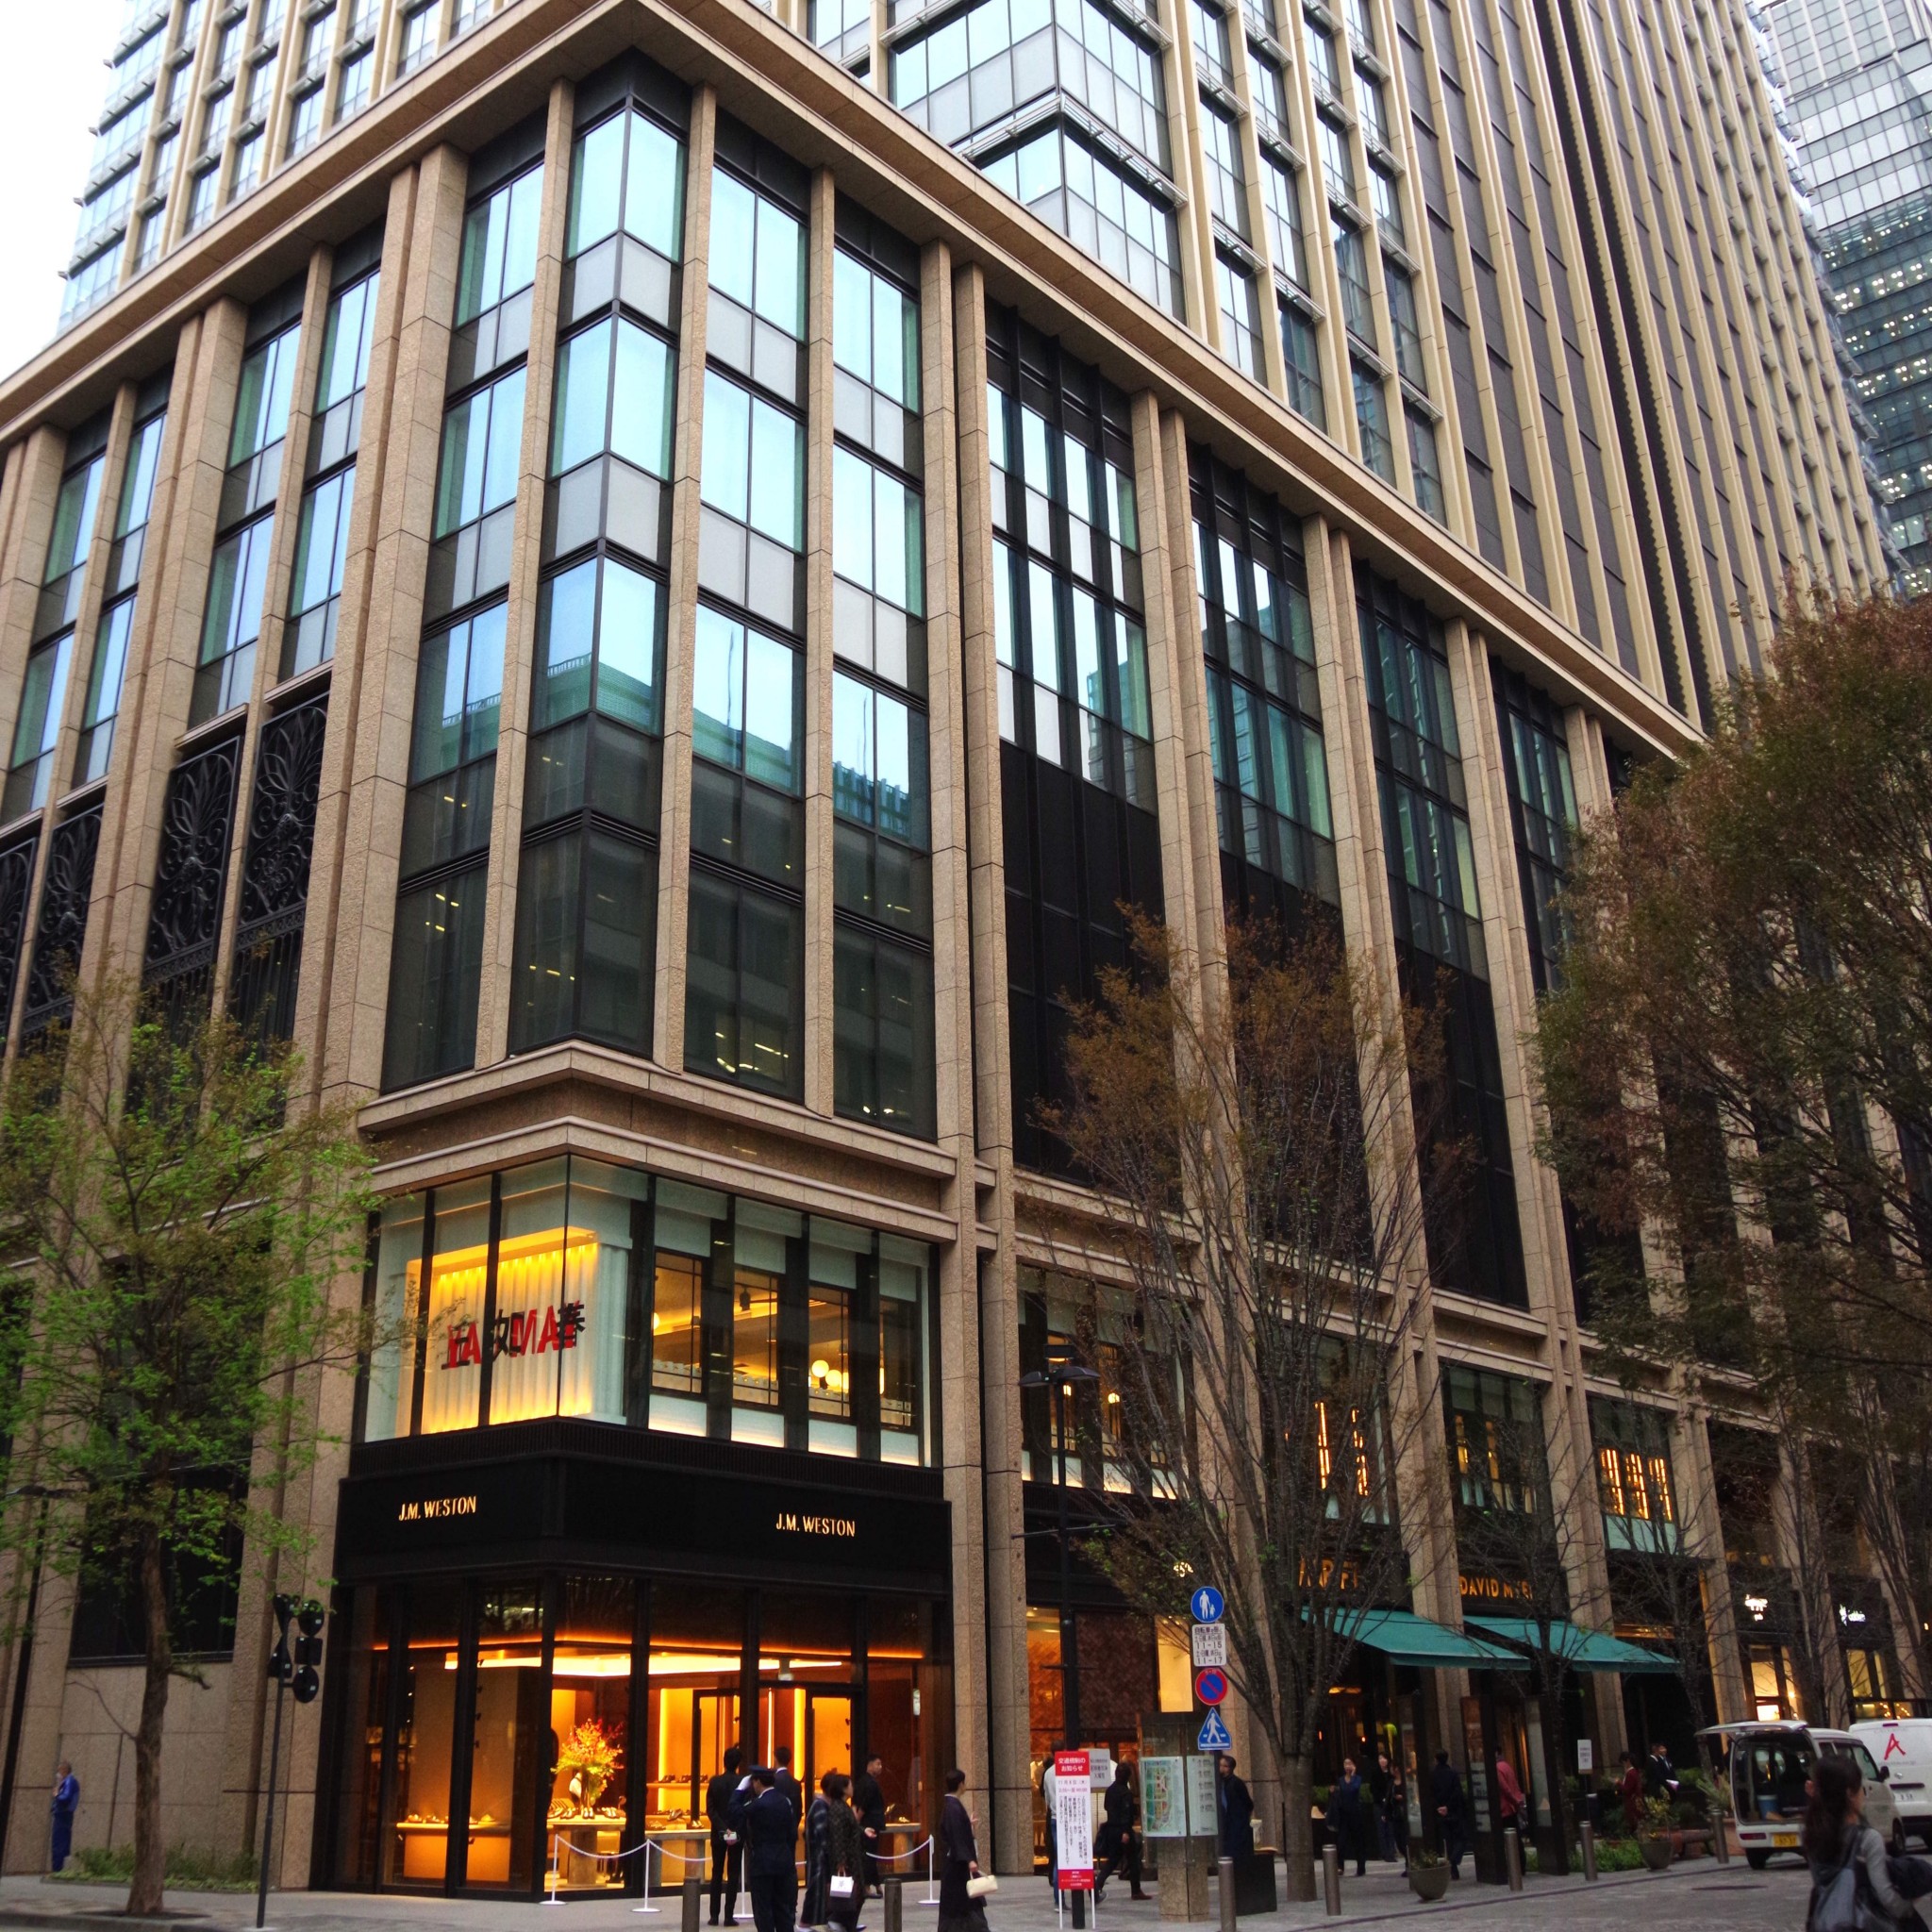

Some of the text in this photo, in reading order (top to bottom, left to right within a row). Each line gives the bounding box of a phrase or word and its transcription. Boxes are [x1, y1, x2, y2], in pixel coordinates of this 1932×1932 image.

[398, 1495, 476, 1521] J.M. WESTON
[775, 1512, 856, 1537] J.M. WESTON
[1458, 1575, 1499, 1598] DAVID
